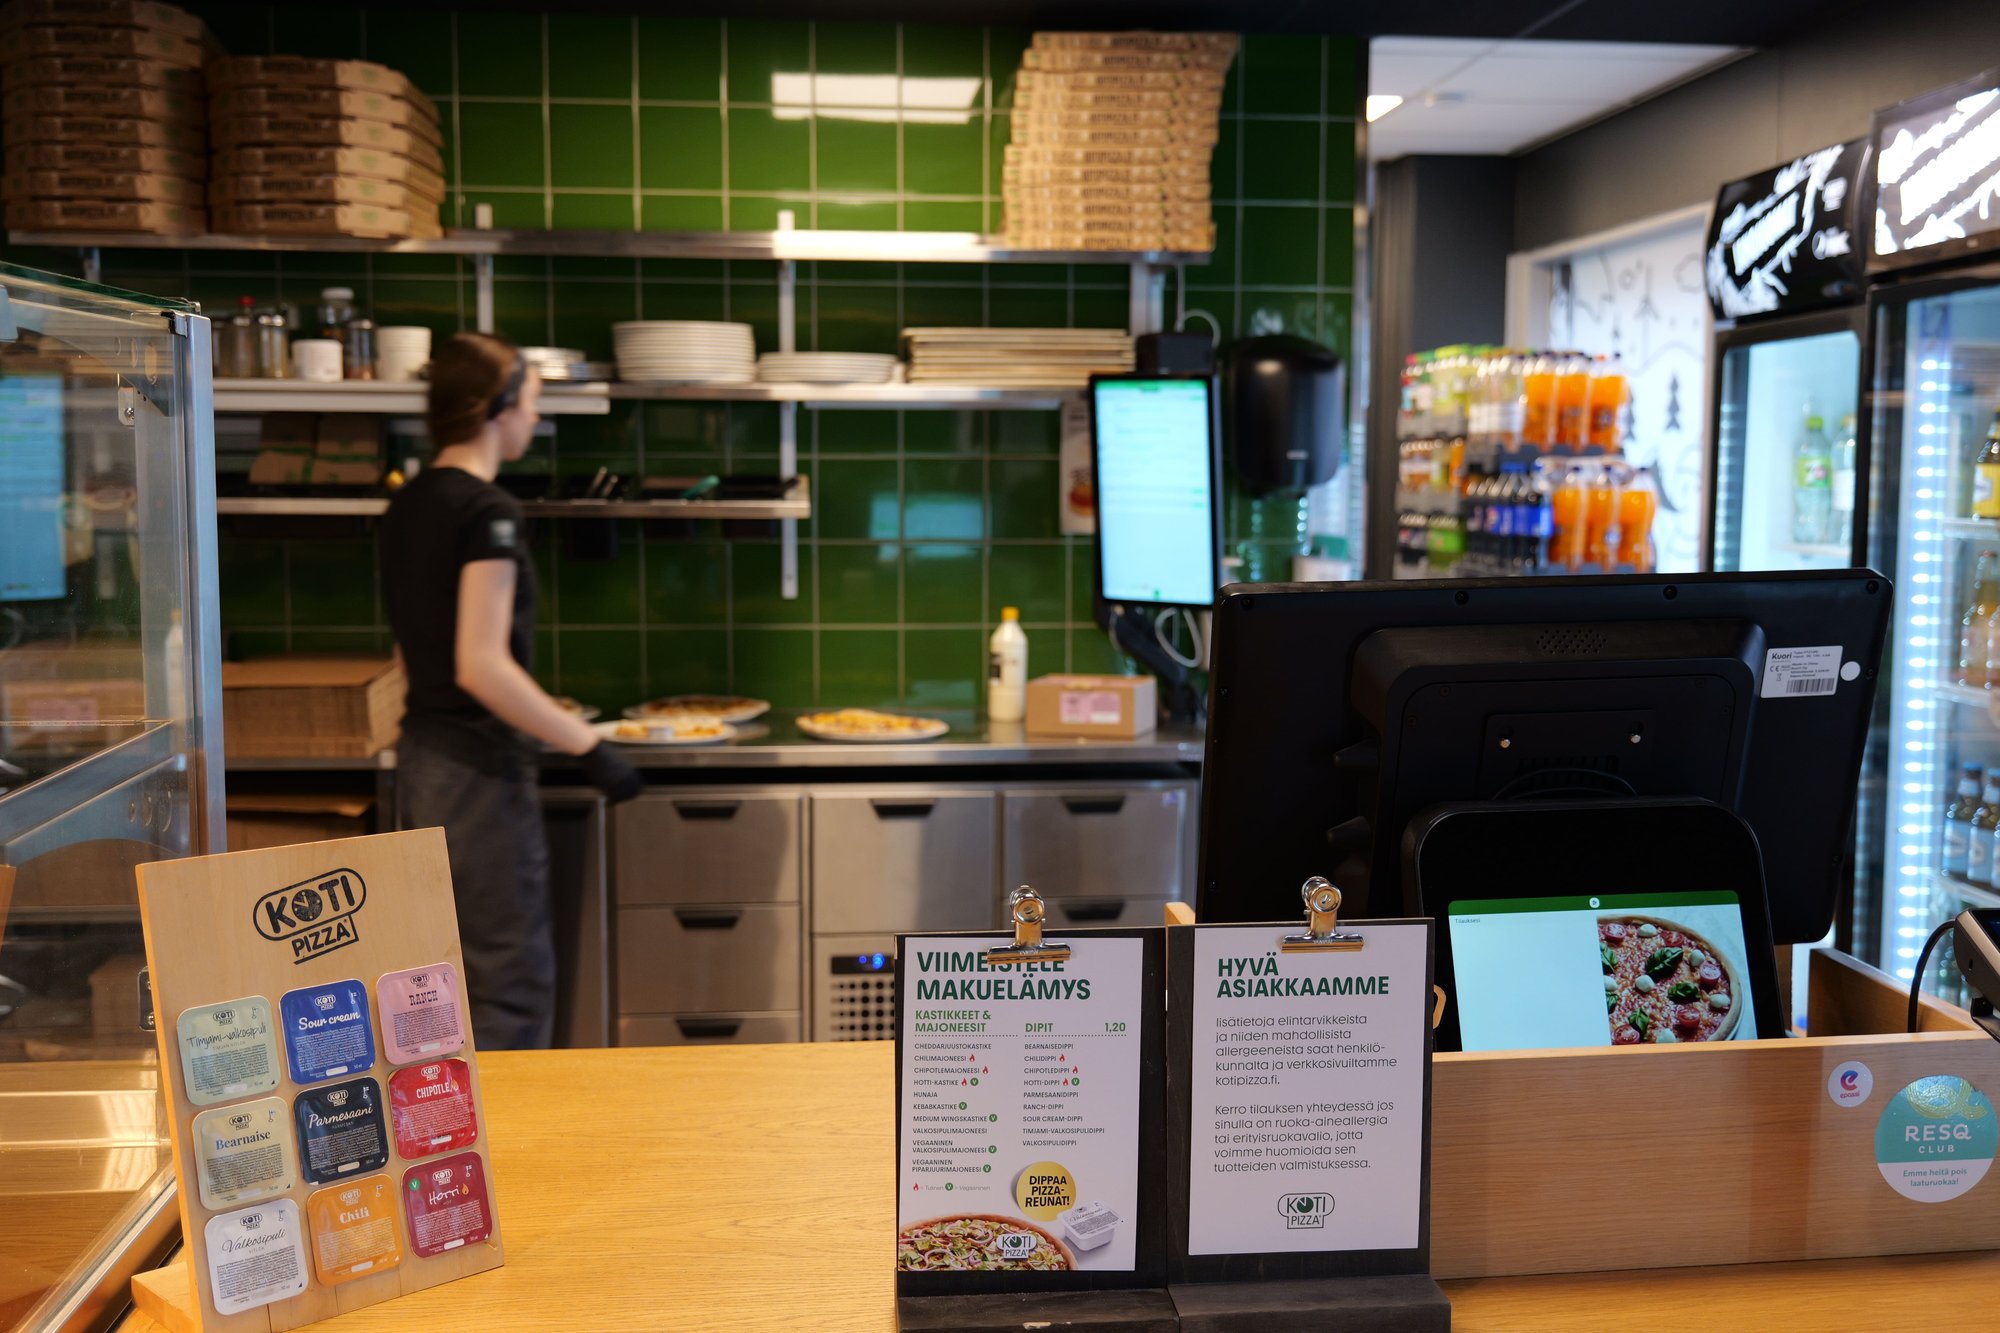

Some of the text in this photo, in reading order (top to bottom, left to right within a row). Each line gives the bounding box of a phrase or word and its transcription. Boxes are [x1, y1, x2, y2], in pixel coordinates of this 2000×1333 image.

[266, 875, 355, 933] KOTI
[292, 922, 350, 957] PIZZA
[1218, 952, 1279, 977] HYVÄ
[917, 973, 1091, 1000] MAKUELÄMYS
[1217, 976, 1389, 998] ASIAKKAAMME
[409, 990, 438, 1006] RANCH
[299, 1011, 360, 1030] Sour cream
[915, 1010, 991, 1020] KASTIKKEET &
[1278, 1015, 1367, 1026] elintarvikkeista
[915, 1023, 986, 1032] MAJONEESIT
[1025, 1023, 1053, 1032] DIPIT
[1104, 1022, 1126, 1033] 1,20
[1216, 1030, 1351, 1043] ja niiden mahdollisista
[1216, 1042, 1386, 1057] allergeeneista saat henkilö-
[1215, 1058, 1397, 1071] kunnalta ja verkkosivuiltamme
[1215, 1075, 1280, 1087] kotipizza.fi.
[416, 1081, 450, 1099] CHIPOTLE
[1215, 1101, 1394, 1115] Kerro tilauksen yhteydessä jos
[309, 1104, 373, 1128] Parmesaani
[1214, 1116, 1388, 1129] sinulla on ruoka-aineallergia
[1214, 1130, 1363, 1144] tai erityisruokavalio, jotta
[1905, 1124, 1972, 1142] RESQ
[216, 1131, 271, 1150] Bearnaise
[1214, 1145, 1356, 1158] voimme huomioida sen
[1918, 1145, 1955, 1154] CLUB
[1214, 1159, 1371, 1172] tuotteiden valmistuksessa.
[1929, 1168, 1949, 1176] heitä
[1951, 1168, 1967, 1178] pois
[1030, 1176, 1067, 1185] DIPPAA
[1910, 1179, 1959, 1187] laaturuokaa!
[1032, 1186, 1064, 1195] PIZZA-
[1025, 1196, 1069, 1207] REUNAT!
[1287, 1196, 1326, 1214] KOTI
[340, 1207, 370, 1224] Chili
[1291, 1215, 1320, 1226] PIZZA
[222, 1228, 286, 1253] Valkosipuli
[1002, 1236, 1031, 1248] KOTI
